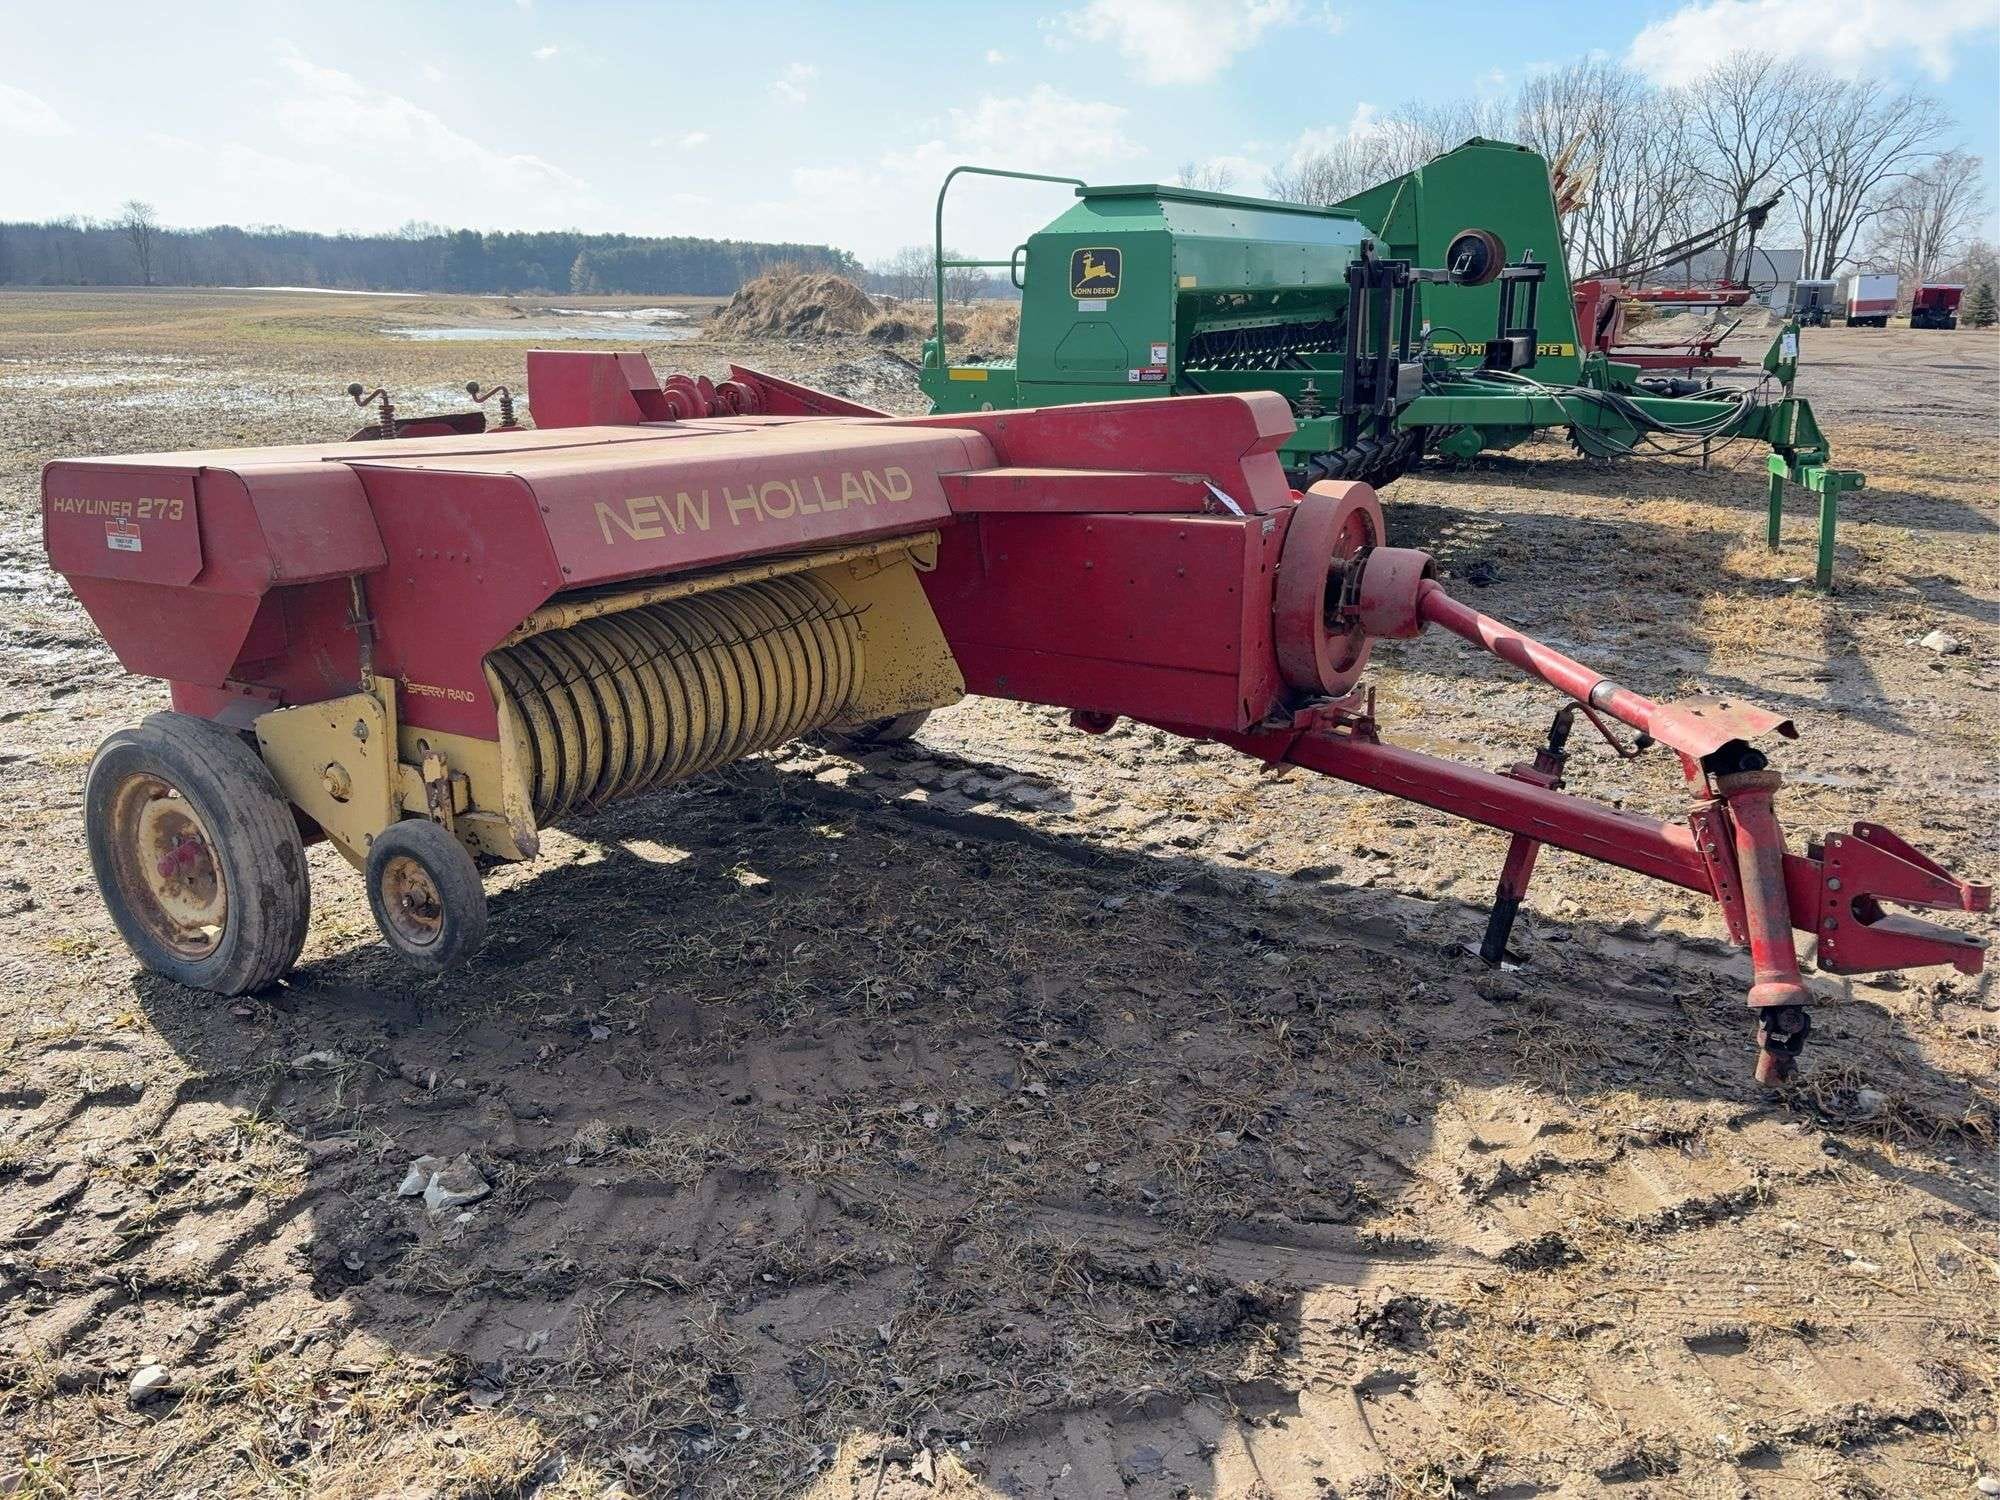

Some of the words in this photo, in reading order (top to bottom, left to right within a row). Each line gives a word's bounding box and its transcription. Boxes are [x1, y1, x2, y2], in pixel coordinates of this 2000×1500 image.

[1073, 287, 1092, 296] JOHN
[1092, 287, 1117, 296] DEERE
[1447, 343, 1487, 356] JOH
[53, 497, 132, 518] HAYLINER
[136, 497, 184, 521] 273
[593, 489, 711, 546] NEW
[722, 465, 913, 527] HOLLAND
[407, 682, 447, 699] SPERRY
[446, 688, 476, 703] RAND
